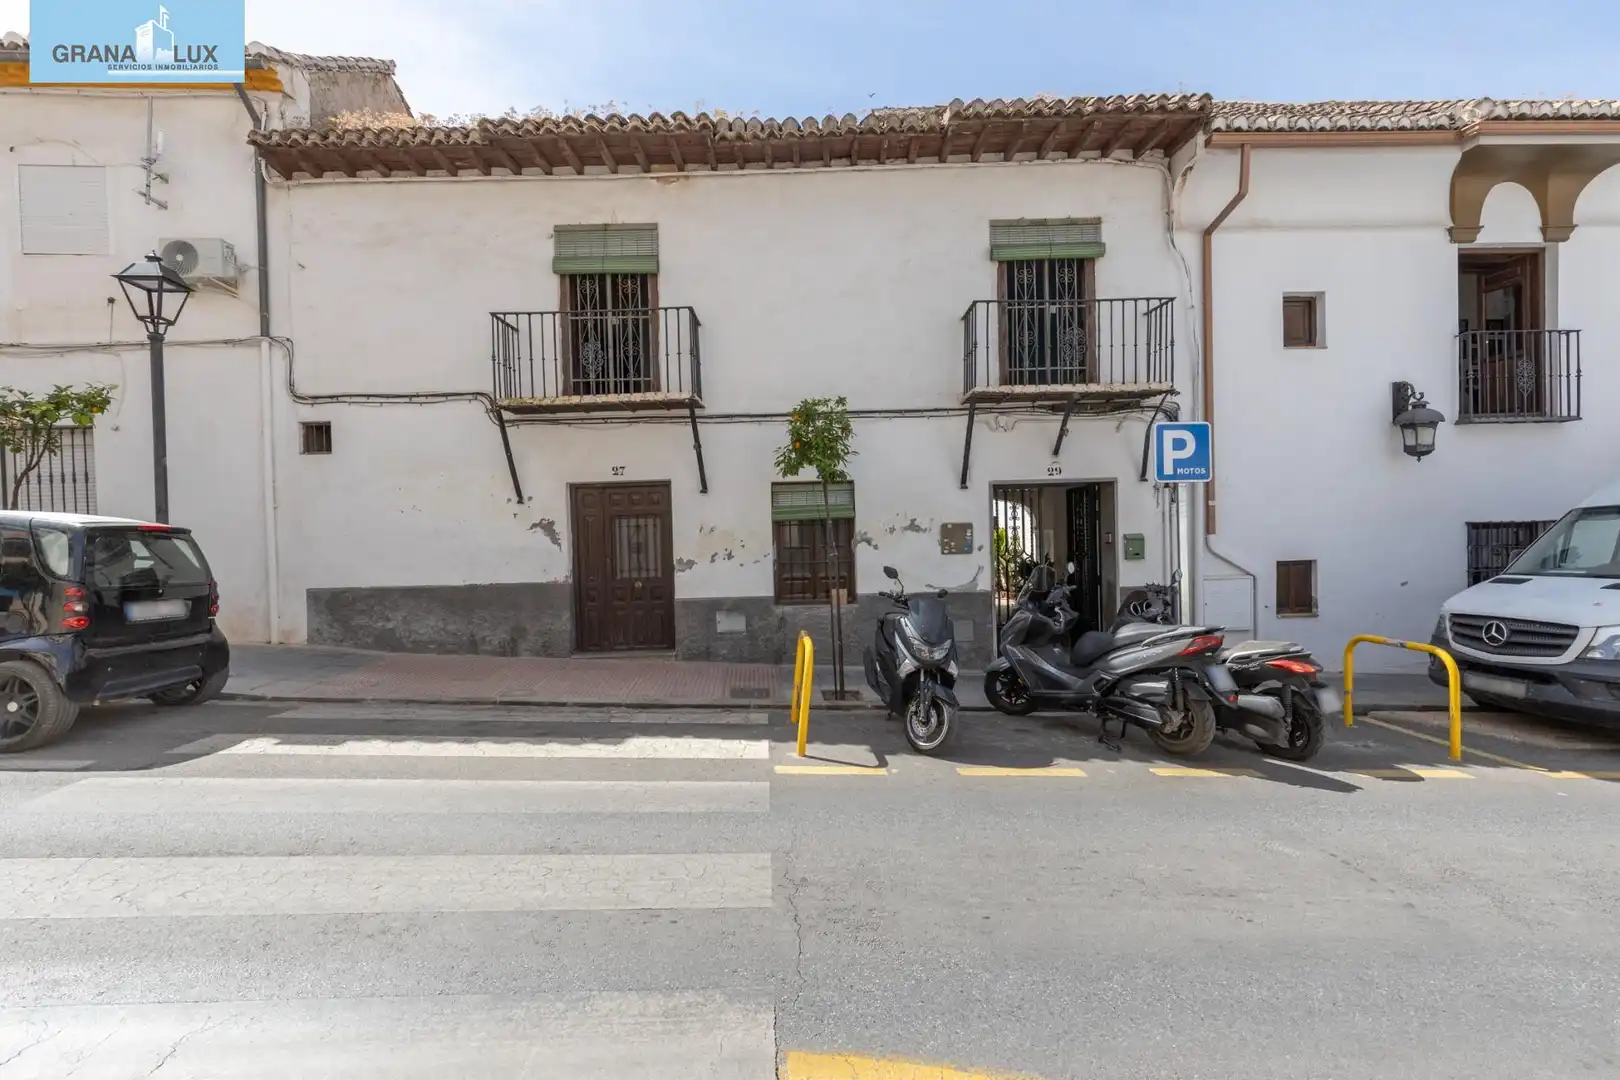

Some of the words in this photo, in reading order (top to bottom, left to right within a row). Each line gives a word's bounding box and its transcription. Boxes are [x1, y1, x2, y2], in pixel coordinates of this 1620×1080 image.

[1163, 429, 1196, 475] P
[611, 466, 626, 476] 27
[1047, 466, 1062, 477] 29
[1177, 467, 1206, 475] MOTOS
